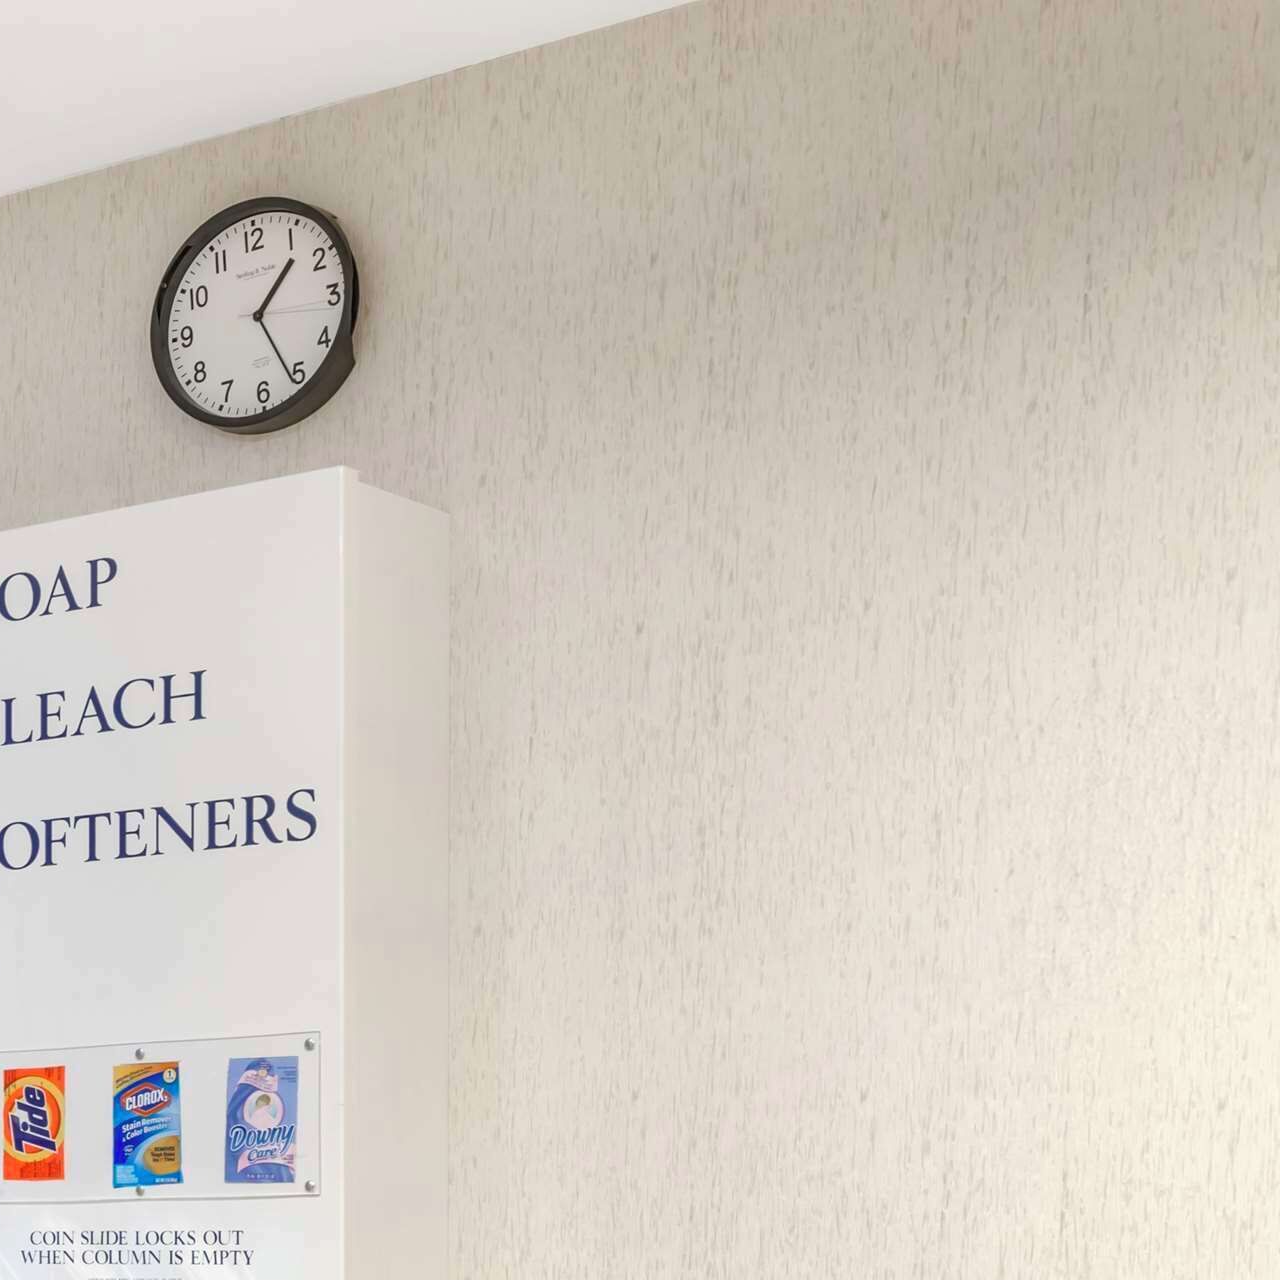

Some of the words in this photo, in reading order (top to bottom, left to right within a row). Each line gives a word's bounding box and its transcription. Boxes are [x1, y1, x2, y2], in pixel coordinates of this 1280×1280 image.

[244, 227, 265, 254] 12
[288, 228, 294, 251] 1
[214, 250, 228, 275] 11
[312, 247, 327, 272] 2
[189, 285, 209, 310] 10
[326, 283, 341, 306] 3
[180, 326, 194, 348] 9
[317, 325, 332, 348] 4
[193, 361, 207, 383] 8
[292, 361, 306, 385] 5
[221, 380, 234, 403] 7
[256, 380, 271, 404] 6
[8, 1085, 57, 1153] Tide
[122, 1119, 141, 1134] Stain
[126, 1126, 143, 1140] Color
[230, 1124, 295, 1153] Downy
[29, 1230, 76, 1246] COIN
[80, 1230, 128, 1246] SLIDE
[134, 1230, 197, 1246] LOCKS
[203, 1229, 244, 1246] OUT
[20, 1249, 76, 1265] WHEN
[81, 1249, 162, 1265] COLUMN
[168, 1249, 185, 1265] IS
[191, 1249, 255, 1266] EMPTY
